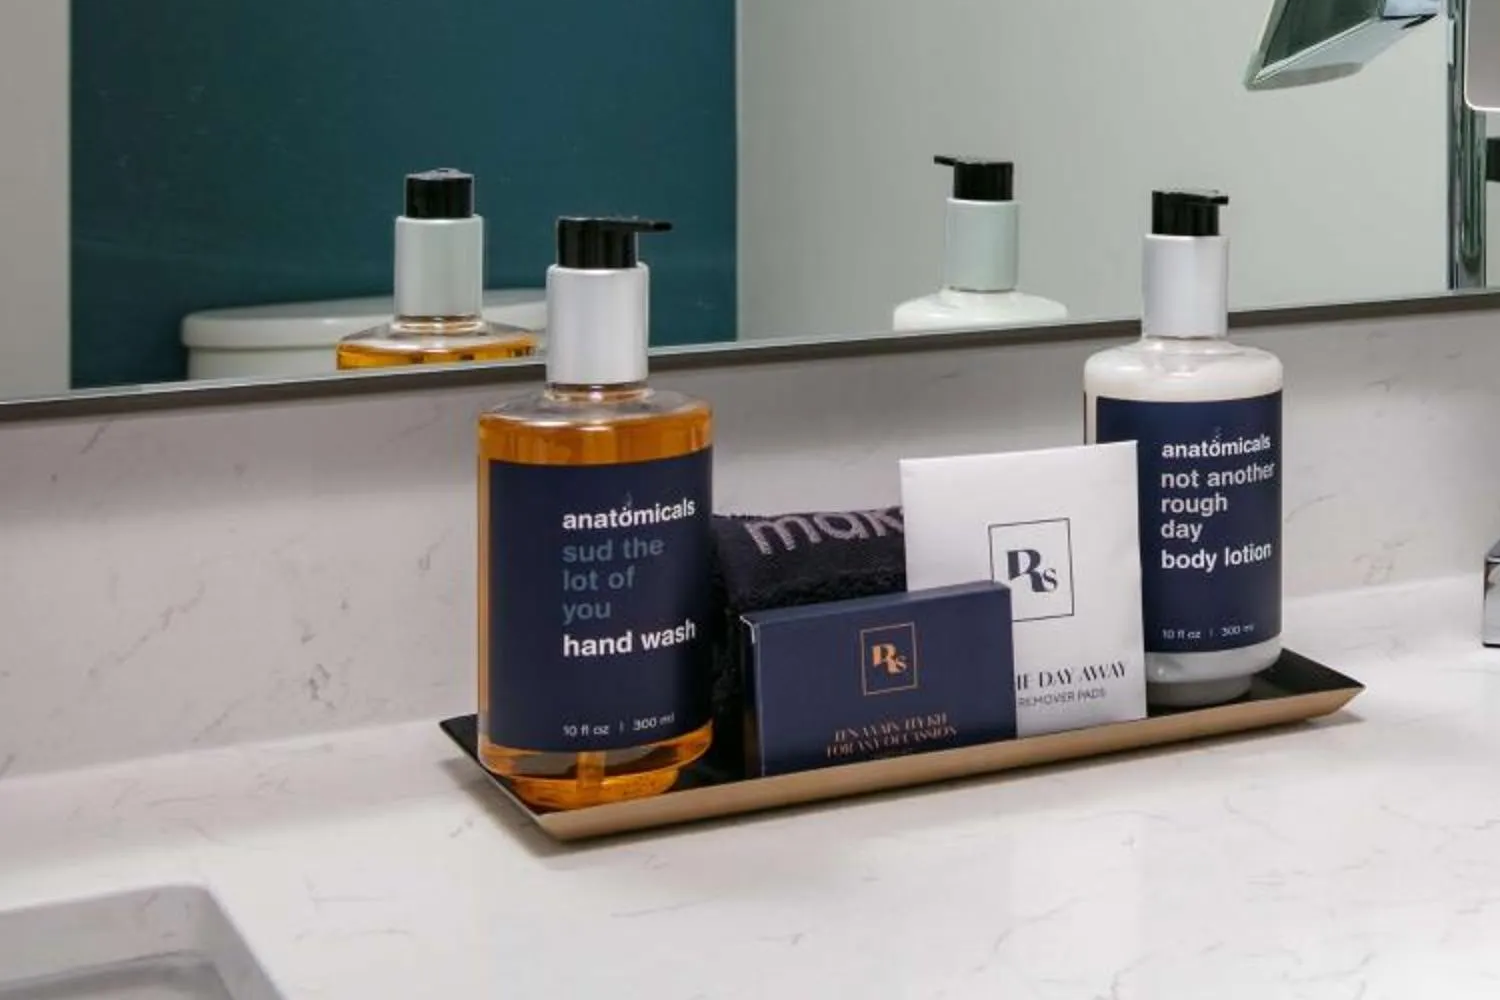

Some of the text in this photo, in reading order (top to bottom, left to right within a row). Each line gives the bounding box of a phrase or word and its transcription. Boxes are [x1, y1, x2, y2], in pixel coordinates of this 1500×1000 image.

[1161, 461, 1276, 489] not another
[1161, 494, 1228, 517] rough
[1161, 520, 1203, 543] day
[562, 534, 665, 564] sud the
[1161, 542, 1273, 573] body lotion
[563, 565, 635, 592] lot of
[562, 601, 612, 625] you
[563, 619, 697, 657] hand wash
[1162, 629, 1175, 639] 10
[1221, 625, 1241, 637] 300
[1038, 667, 1073, 688] DAY
[1080, 660, 1128, 682] AWAY
[1018, 691, 1075, 707] REMOVER
[562, 711, 675, 737] 10 fl oz 300 ml
